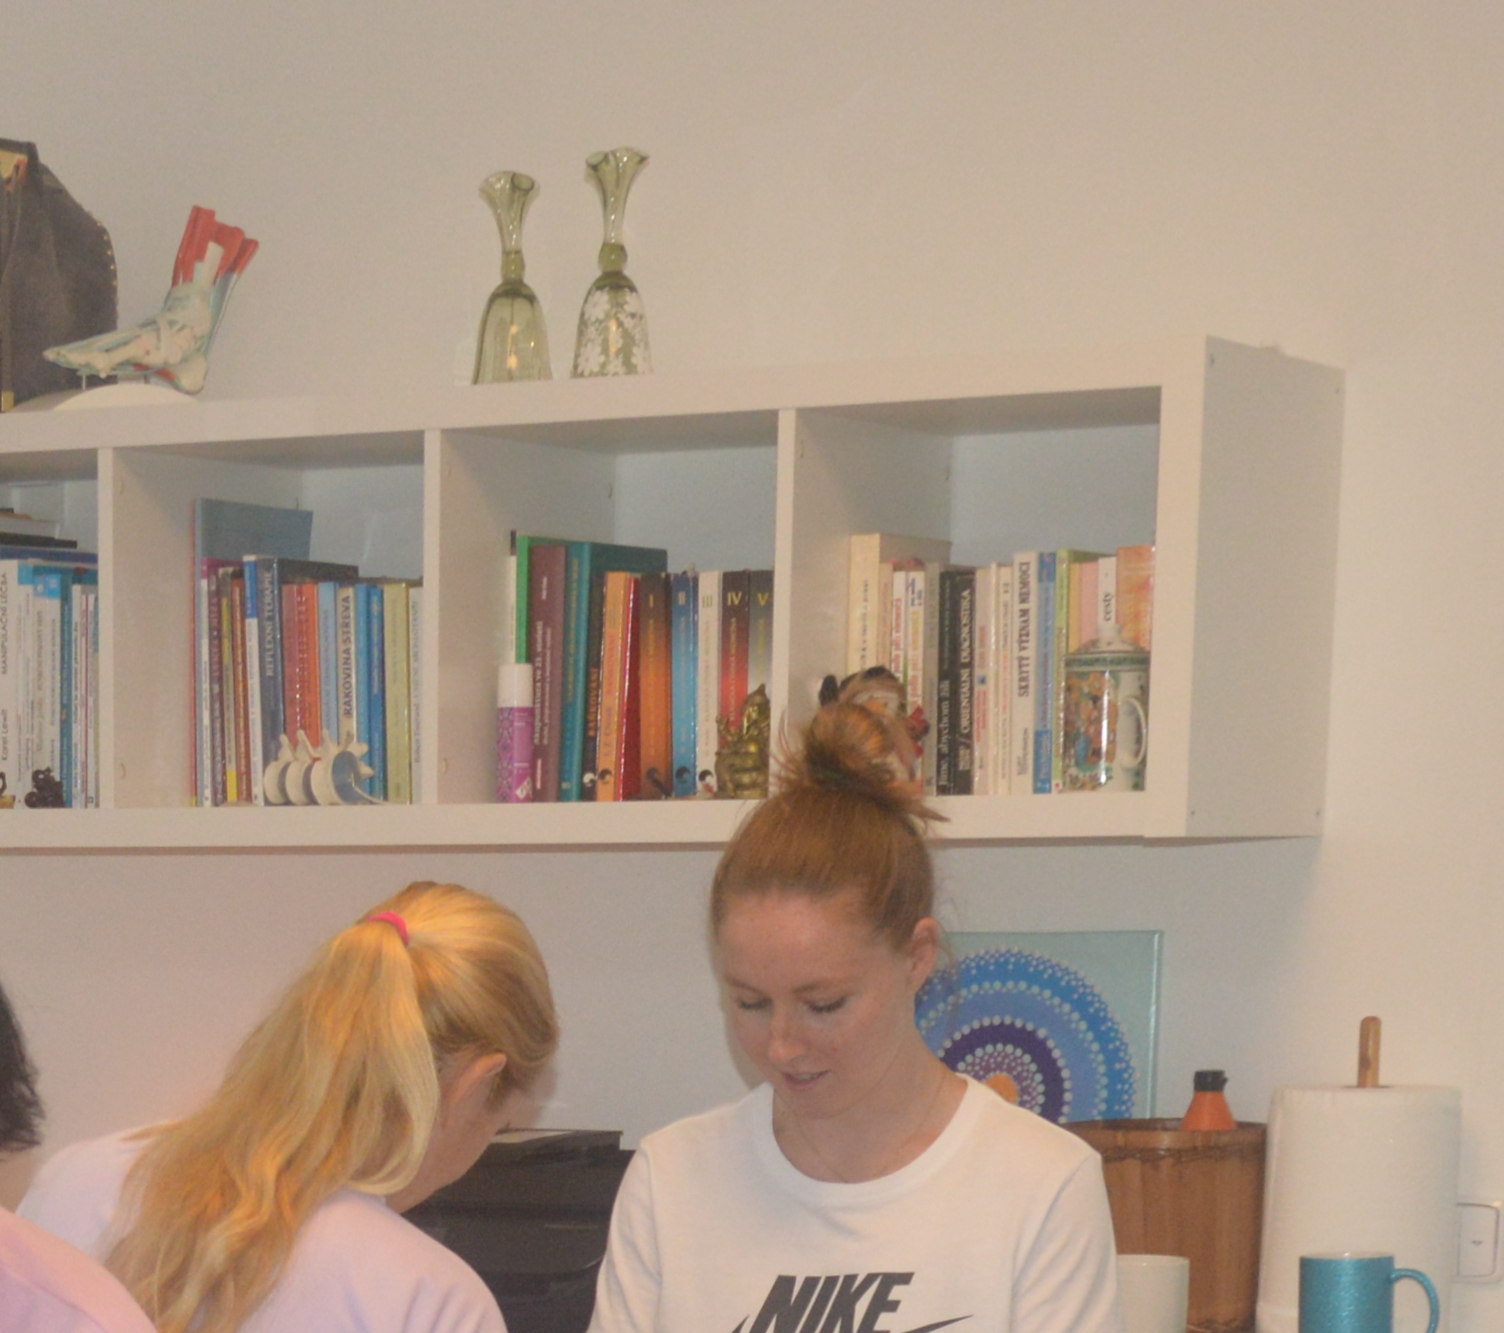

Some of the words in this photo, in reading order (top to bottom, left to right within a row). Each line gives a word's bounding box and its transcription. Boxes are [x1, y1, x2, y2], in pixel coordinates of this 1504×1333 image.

[265, 570, 273, 617] TERAPIE
[703, 595, 713, 608] III
[729, 591, 743, 606] IV
[758, 592, 769, 606] V
[1020, 561, 1031, 604] NEMOCI
[342, 596, 351, 644] STŘEVA
[961, 589, 971, 663] DIAGNOSTIKA
[1017, 608, 1030, 651] VÝZNAM
[1104, 592, 1114, 622] cesty
[0, 606, 8, 674] MANIPULAČNÍ
[265, 621, 274, 676] REFLEXNÍ
[344, 649, 353, 715] RAKOVINA
[940, 680, 950, 698] žili
[1017, 655, 1030, 697] SKRYTÝ
[534, 683, 543, 745] Akupunktura
[588, 667, 598, 737] BAŇKOVÁNÍ
[961, 668, 971, 733] ORIENTÁLNÍ
[940, 701, 951, 754] abychom
[939, 757, 950, 786] Jíme,
